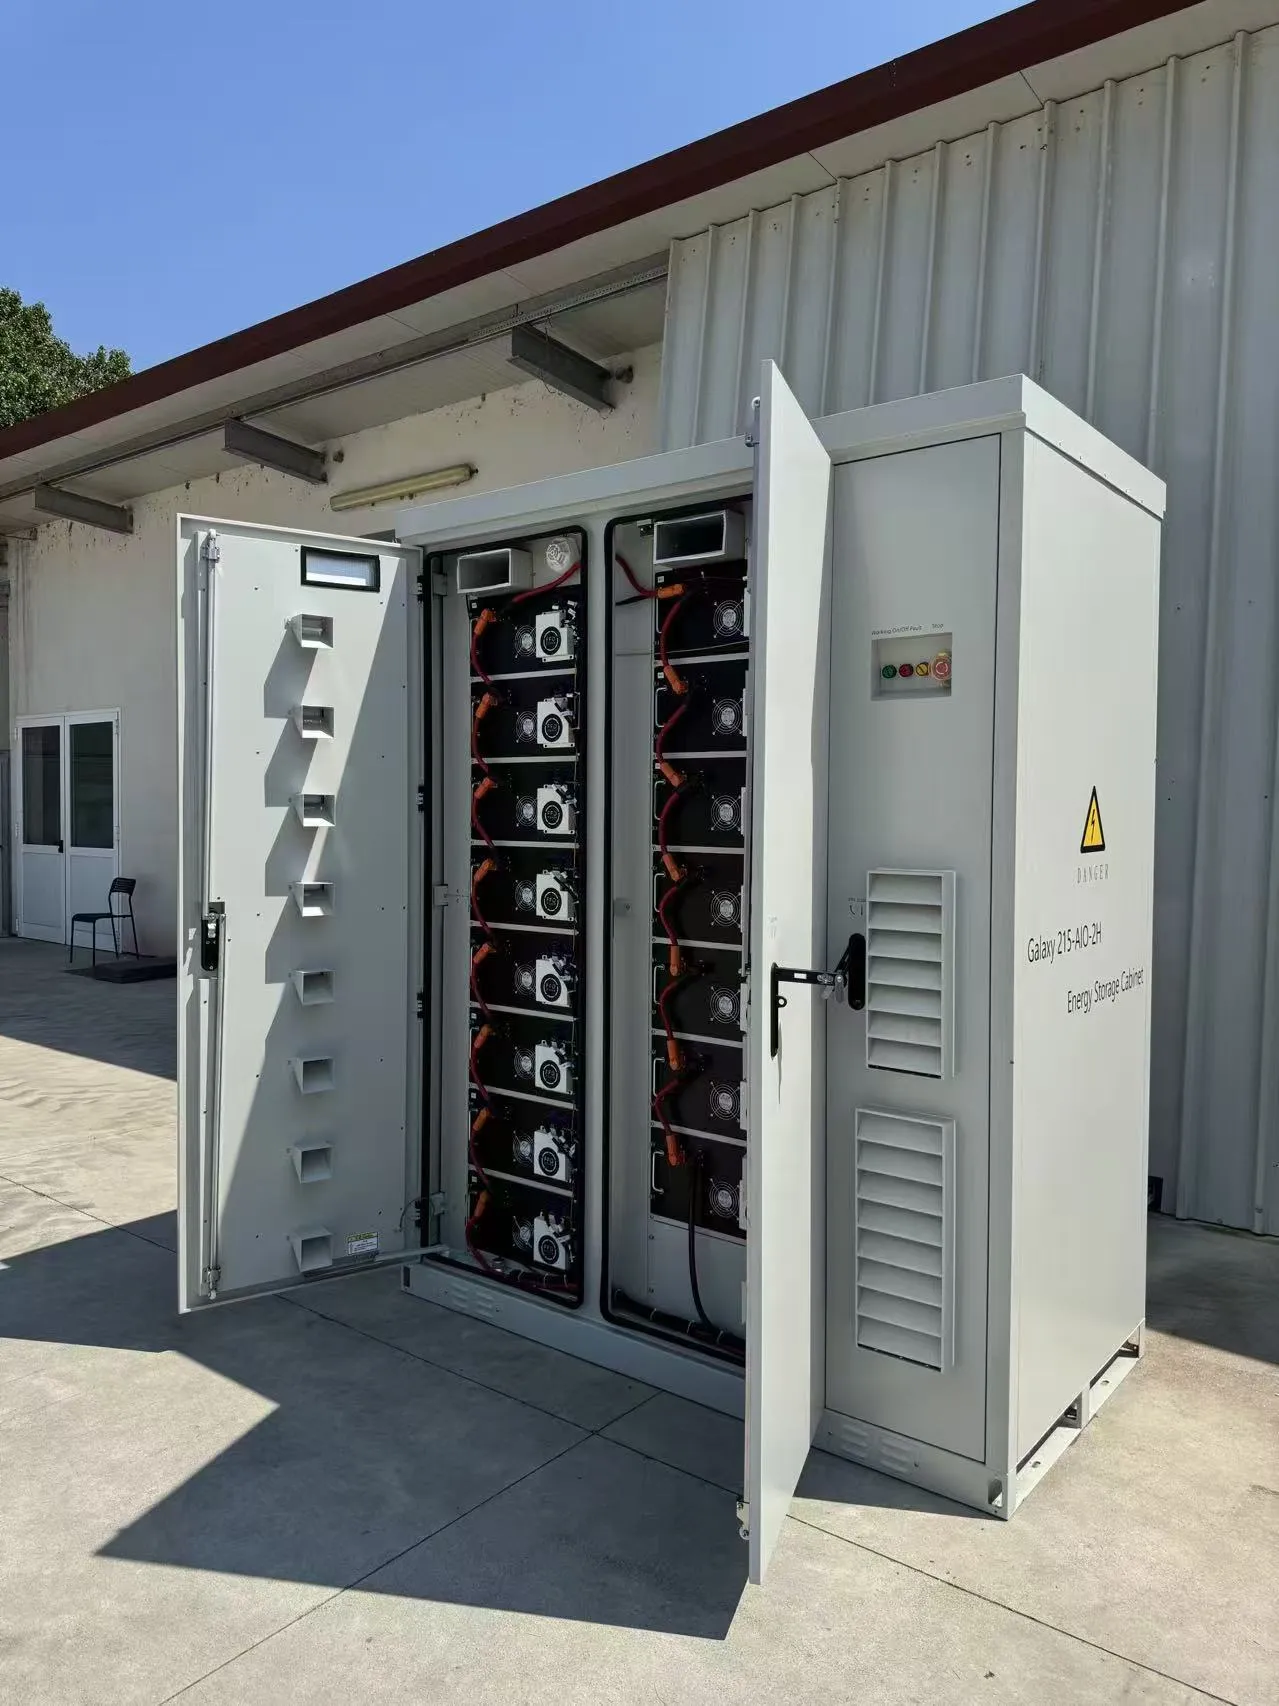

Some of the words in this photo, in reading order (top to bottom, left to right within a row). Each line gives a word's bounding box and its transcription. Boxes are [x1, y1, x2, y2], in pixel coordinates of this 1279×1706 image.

[1077, 864, 1109, 884] DANGER
[1027, 935, 1055, 964] Galaxy
[1057, 922, 1102, 955] 215-AIO-2H
[1067, 988, 1093, 1013] Energy
[1094, 978, 1119, 1002] Storage
[1121, 967, 1144, 992] Cabinet
